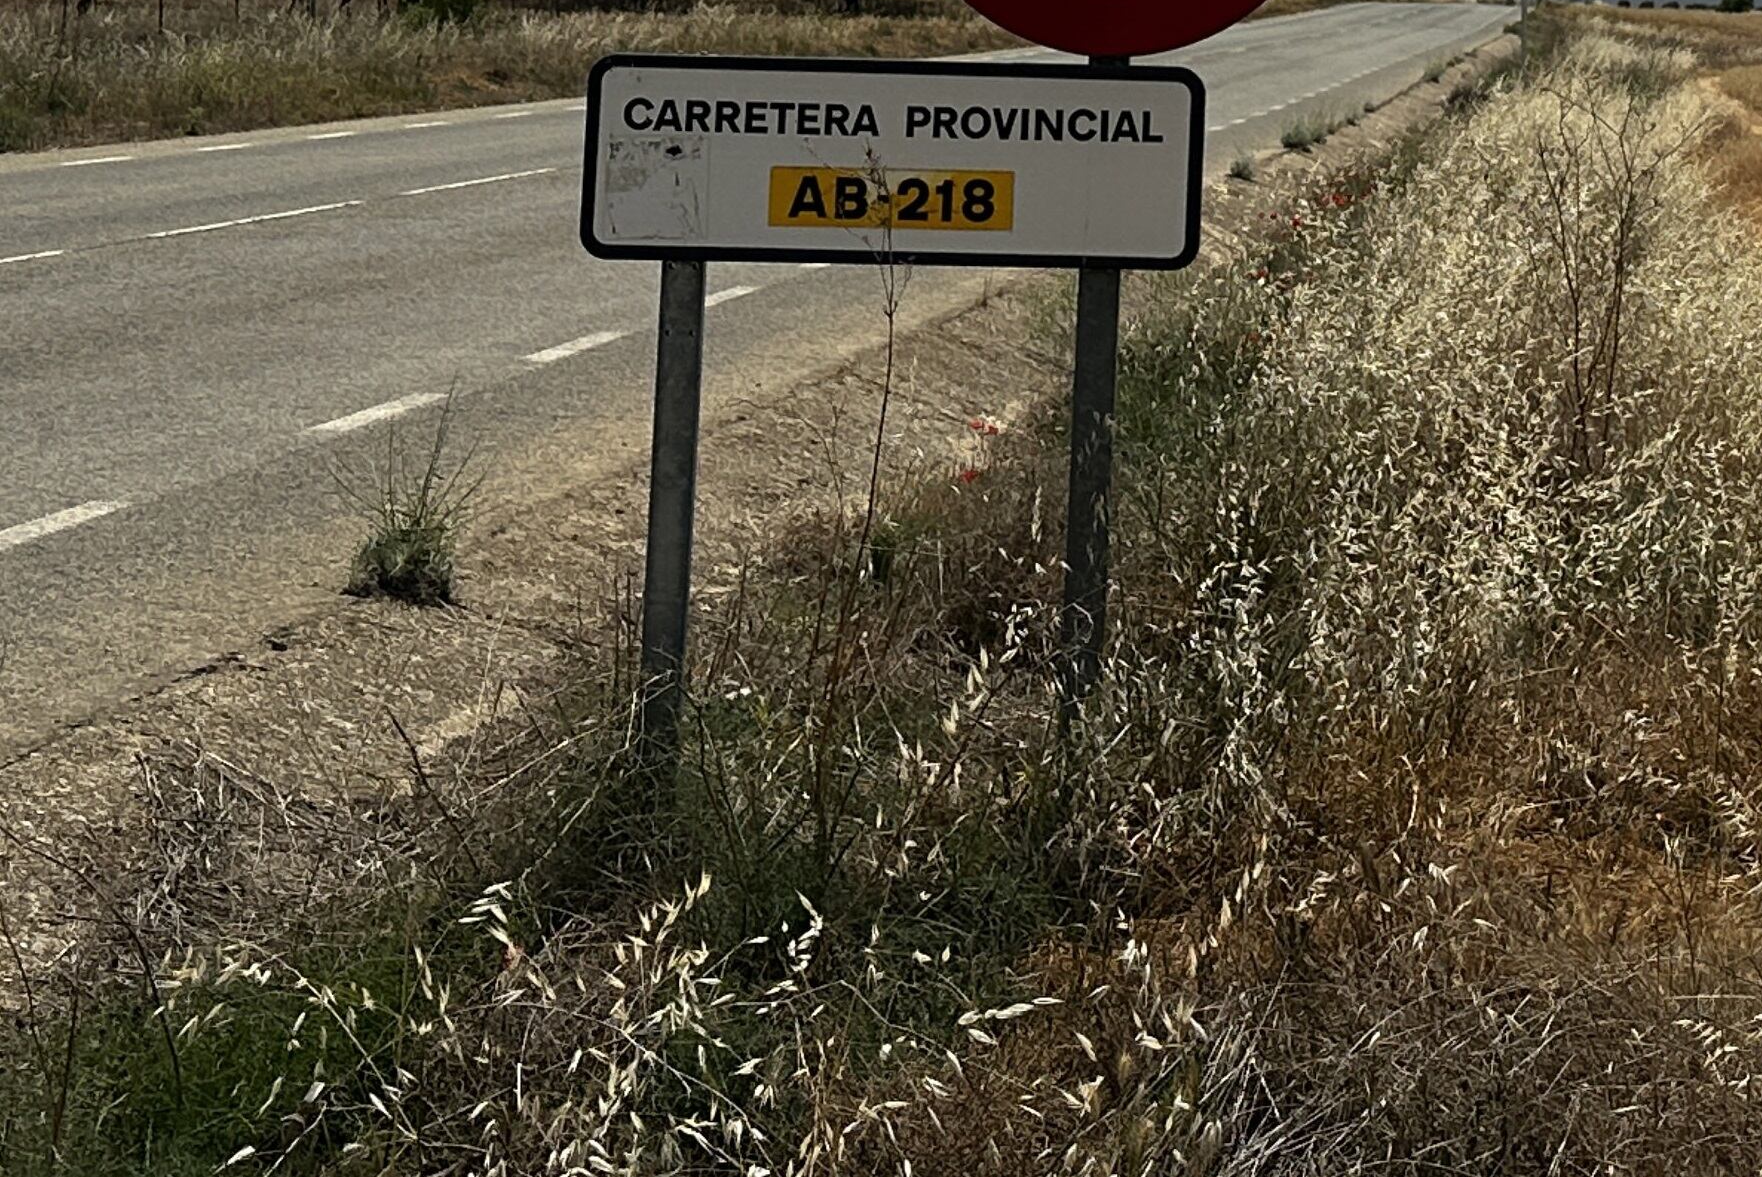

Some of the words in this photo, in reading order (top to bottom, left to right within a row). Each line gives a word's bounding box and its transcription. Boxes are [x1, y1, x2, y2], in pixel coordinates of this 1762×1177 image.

[624, 97, 880, 137] CARRETERA
[905, 106, 1164, 143] PROVINCIAL
[787, 175, 996, 223] AB-218
